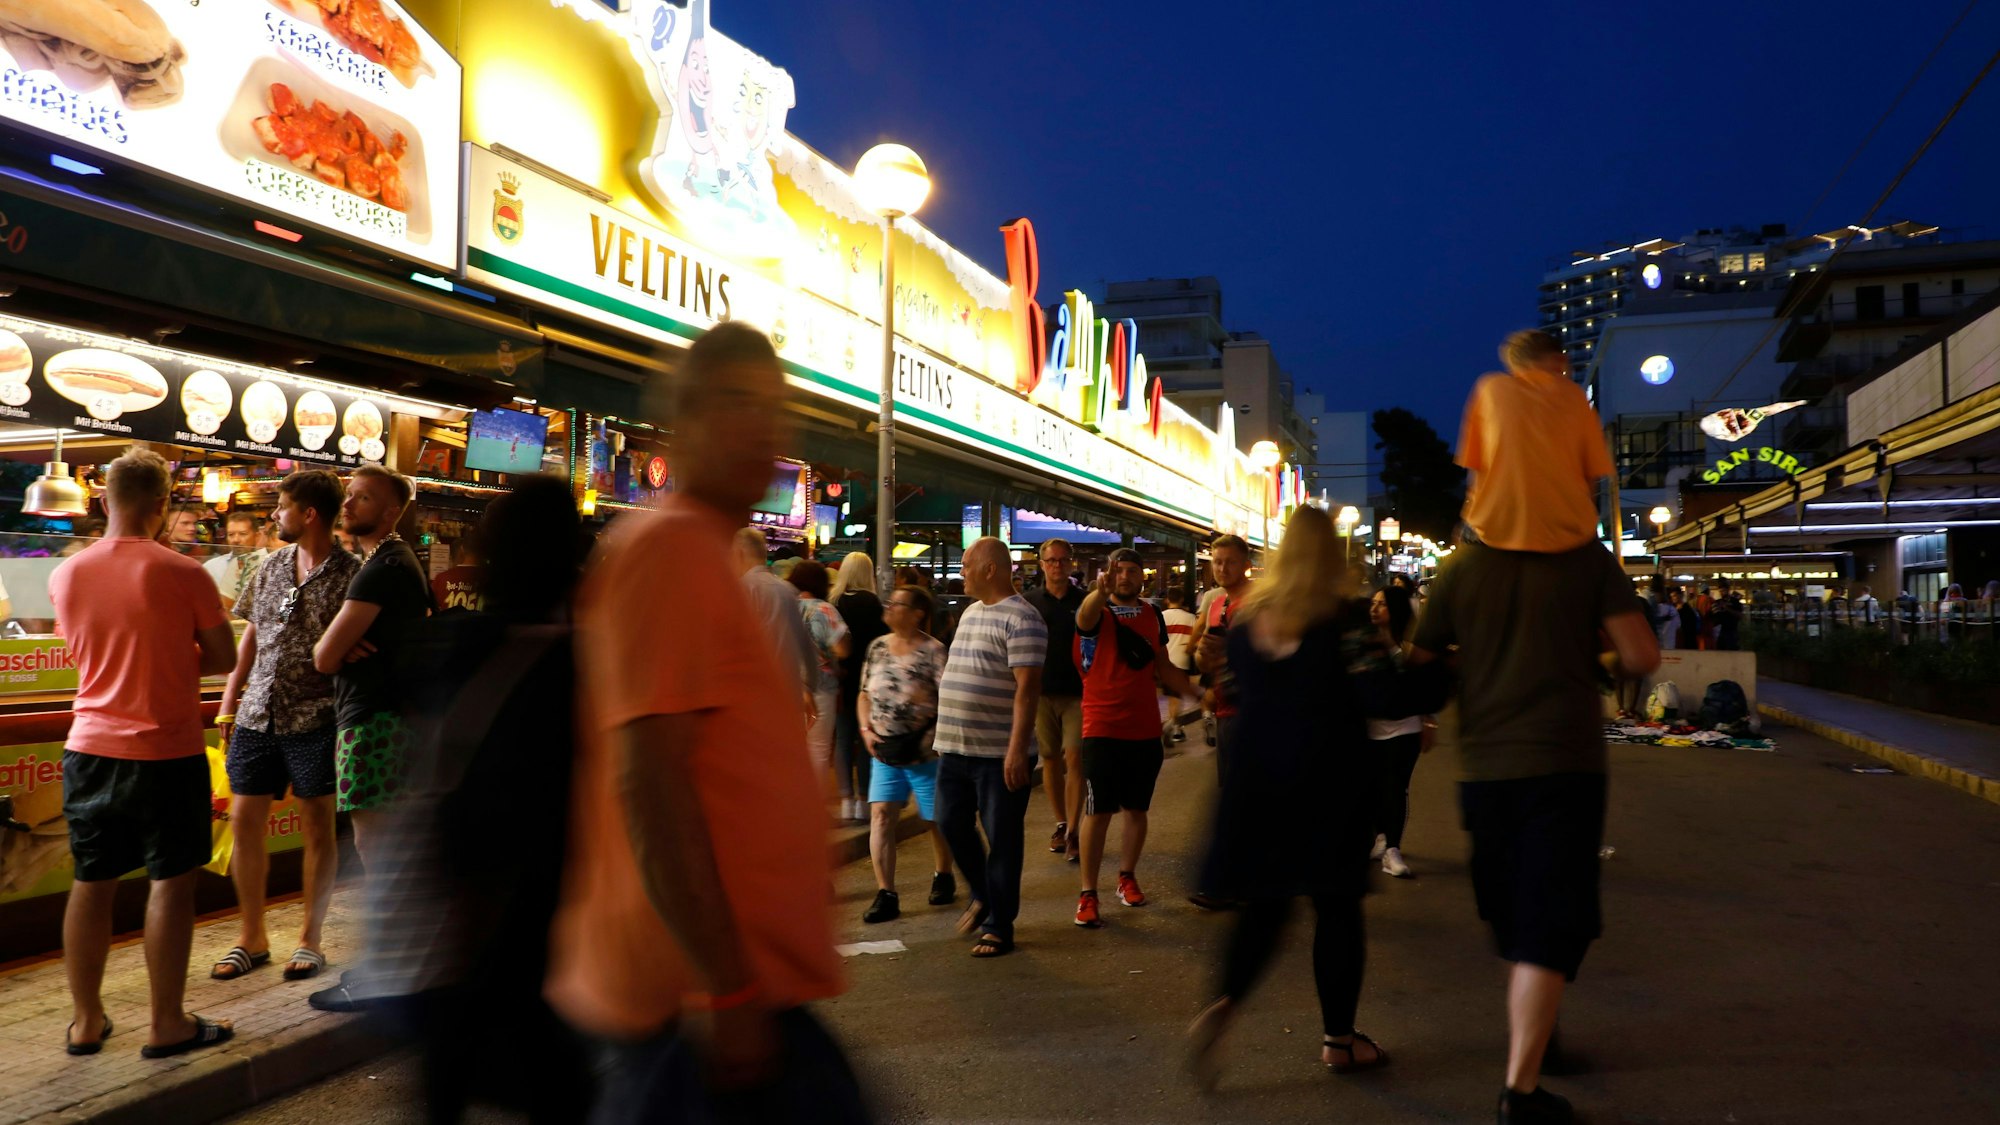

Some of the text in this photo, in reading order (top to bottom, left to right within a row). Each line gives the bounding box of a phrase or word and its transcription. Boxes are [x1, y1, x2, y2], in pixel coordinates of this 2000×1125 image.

[590, 213, 731, 323] VELTINS
[74, 416, 132, 433] Mit Brötchen
[175, 431, 227, 447] Mit Brötchen
[235, 440, 282, 454] Mit Brötchen
[1702, 447, 1750, 485] SAN
[0, 646, 76, 672] aschlik
[9, 673, 39, 683] SOSSE
